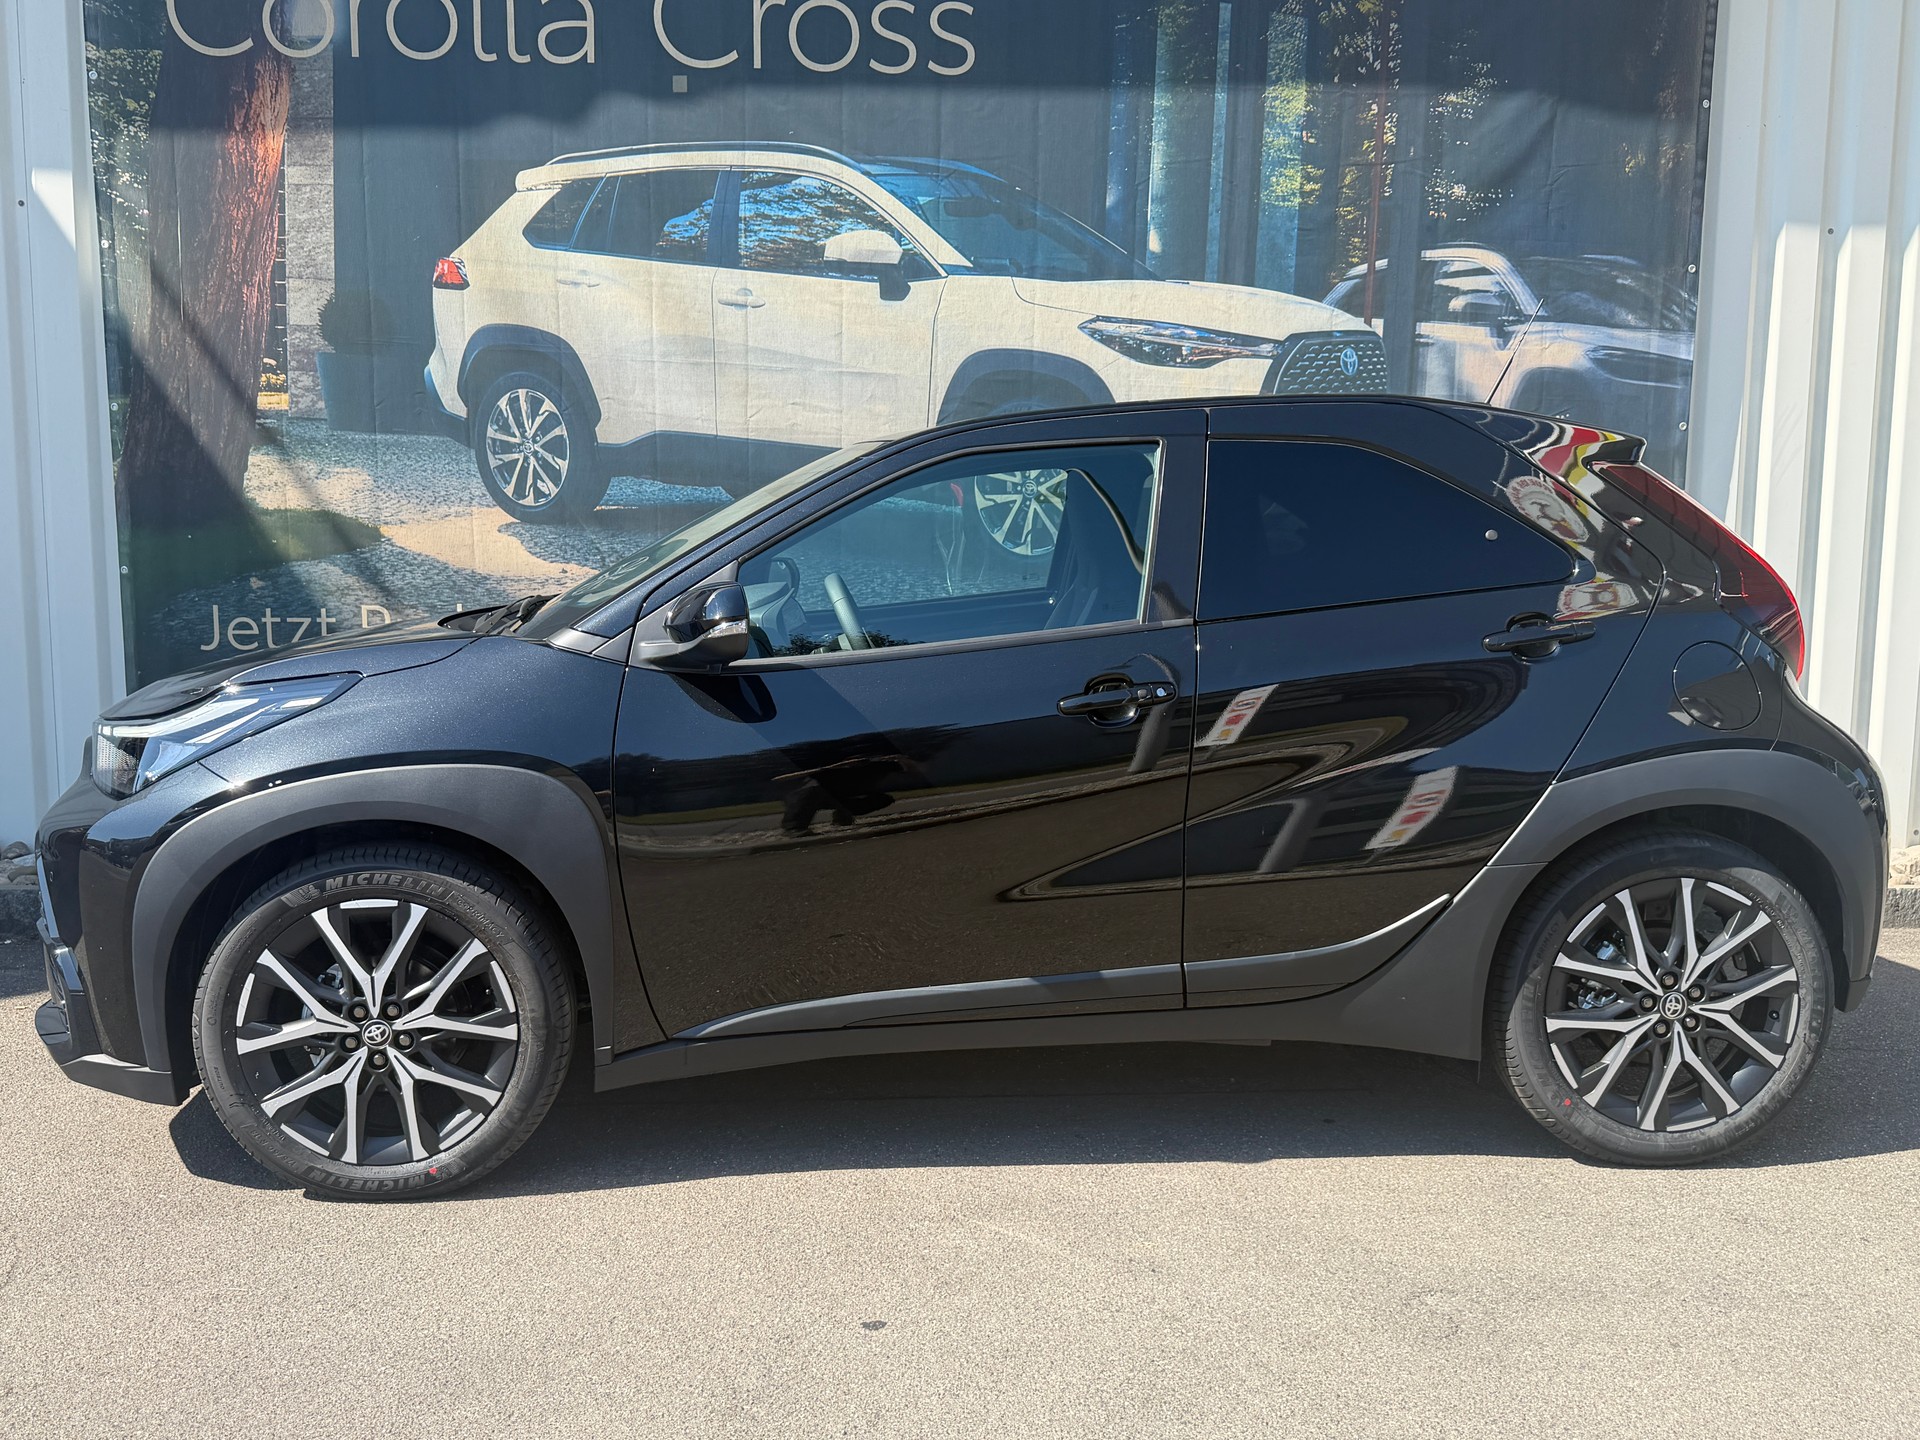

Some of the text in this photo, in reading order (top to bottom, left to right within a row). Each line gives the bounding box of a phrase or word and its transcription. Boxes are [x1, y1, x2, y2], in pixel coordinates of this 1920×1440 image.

[165, 0, 976, 76] Corolla Cross
[201, 604, 336, 651] Jetzt
[325, 872, 447, 897] MICHELIN
[308, 1171, 426, 1192] MICHELIN
